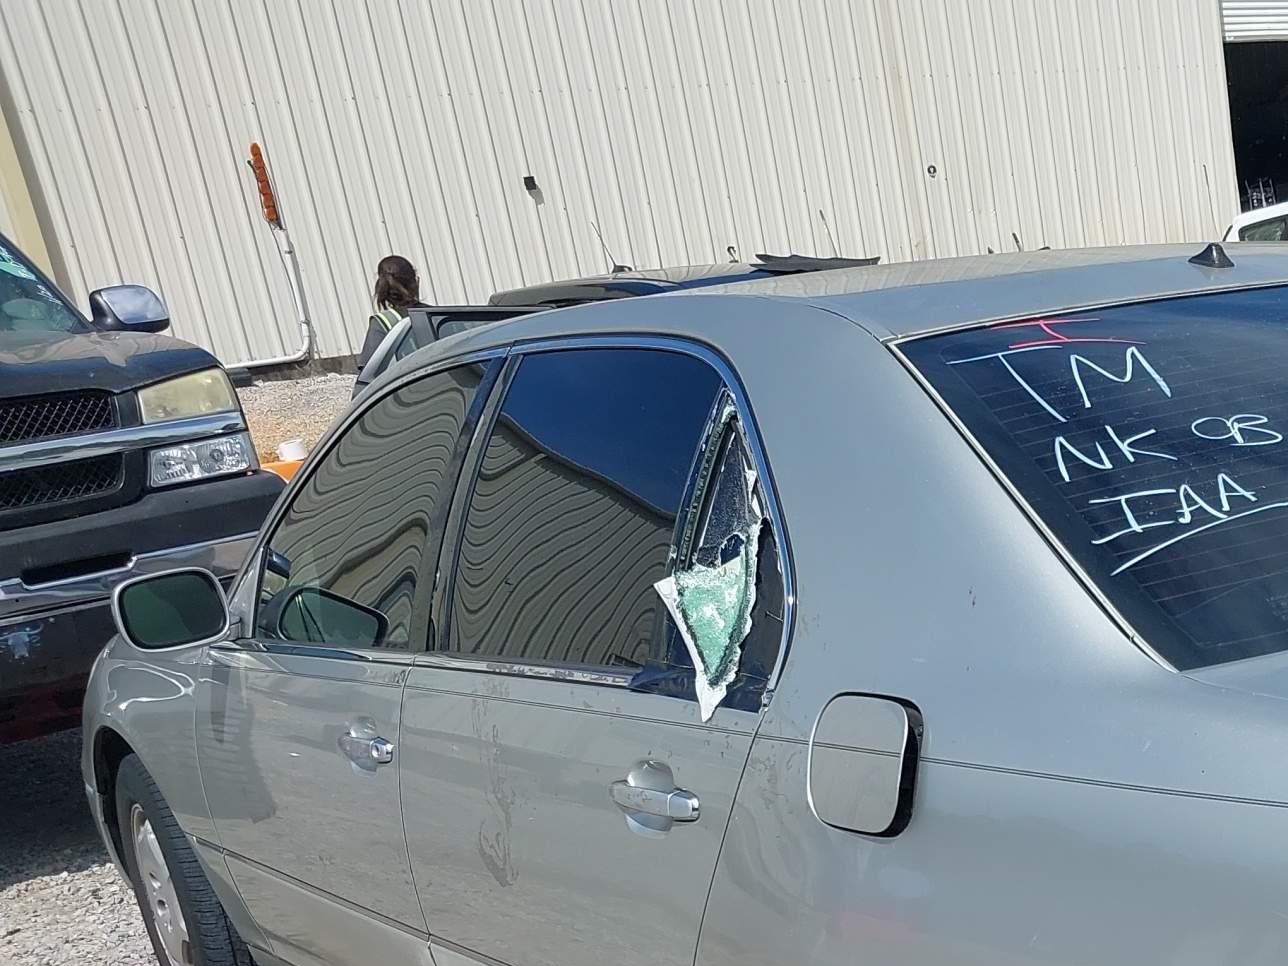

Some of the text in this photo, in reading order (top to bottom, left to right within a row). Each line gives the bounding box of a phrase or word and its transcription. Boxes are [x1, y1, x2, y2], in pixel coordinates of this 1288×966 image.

[945, 345, 1173, 423] TM
[1053, 424, 1179, 483] NK
[1089, 472, 1259, 545] IAA
